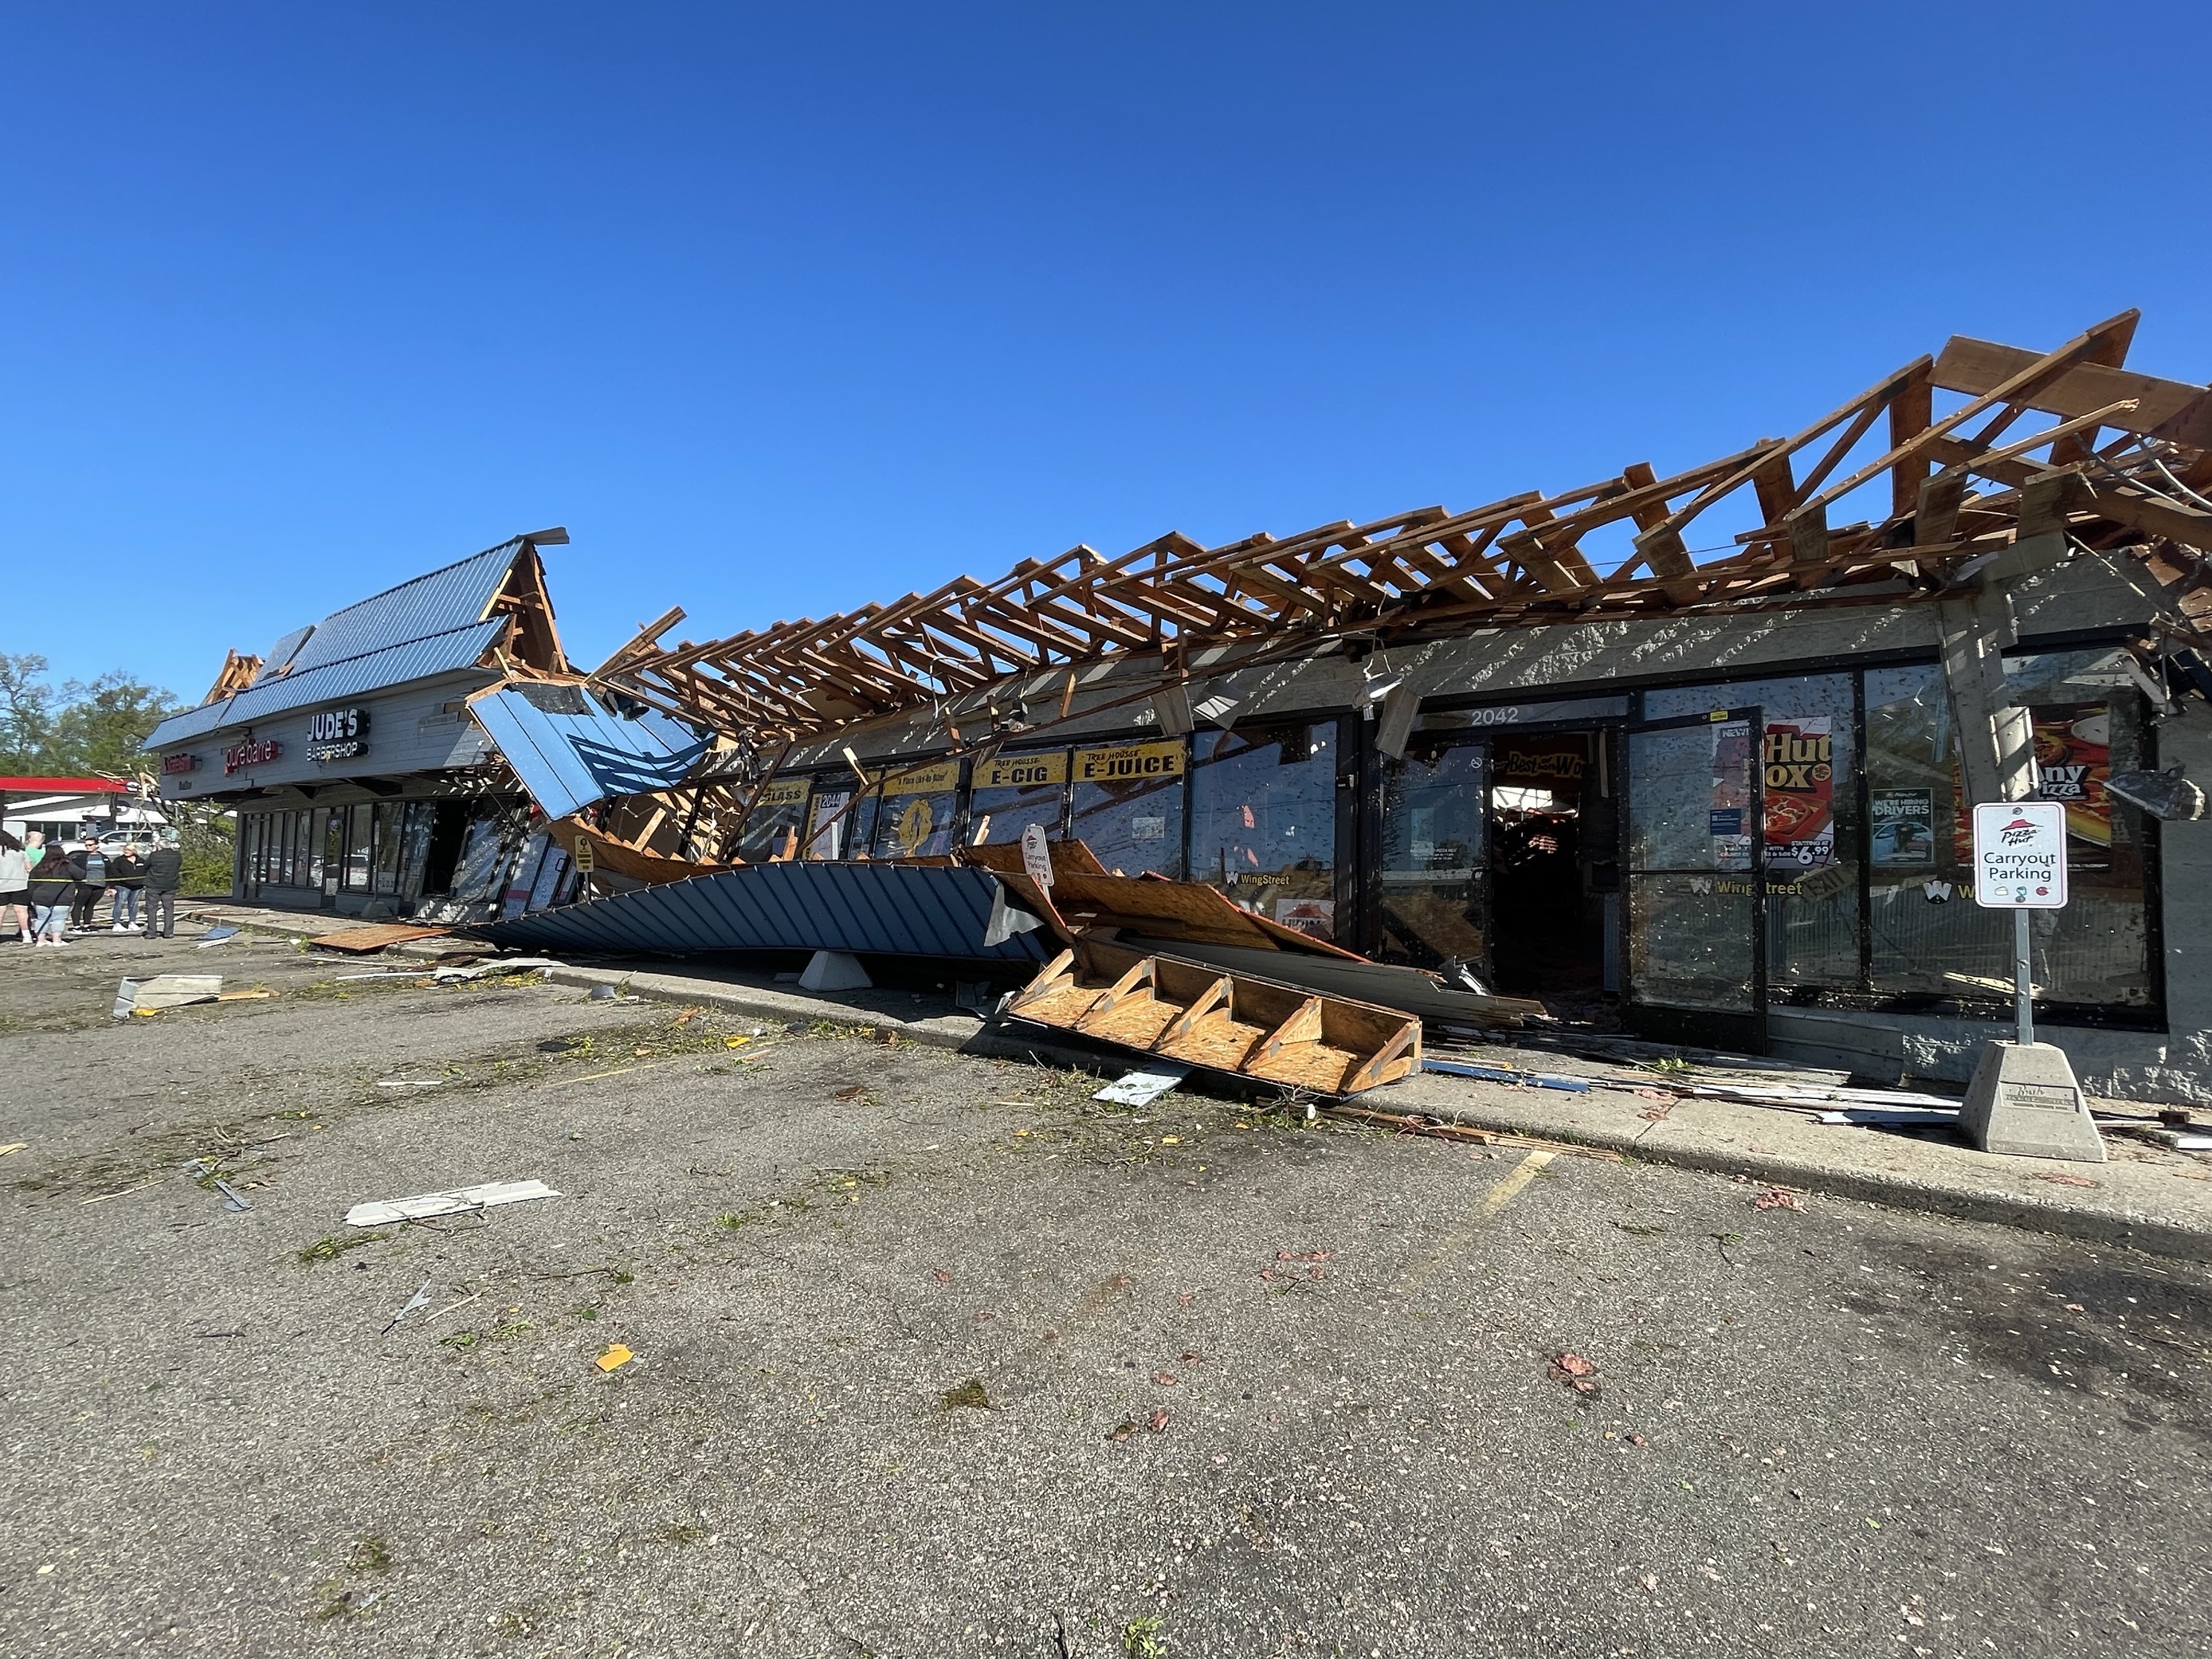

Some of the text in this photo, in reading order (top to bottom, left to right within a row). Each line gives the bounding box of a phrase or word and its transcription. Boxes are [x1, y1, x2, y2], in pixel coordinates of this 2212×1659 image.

[1472, 707, 1519, 726] 2042
[307, 708, 358, 742] JUDE'S
[306, 742, 358, 762] BARBERSHOP
[1766, 732, 1832, 763] Hut
[994, 759, 1011, 769] TREE
[1086, 752, 1107, 763] TREE
[1508, 752, 1538, 775] Best
[1084, 755, 1175, 778] E-JUICE
[991, 767, 1048, 785] E-CIG
[1766, 765, 1812, 788] ox
[763, 790, 802, 802] GLASS
[2038, 781, 2081, 796] izza
[822, 794, 841, 807] 2044
[1875, 806, 1930, 815] DRIVERS
[2001, 829, 2040, 843] Pizza
[2008, 836, 2034, 846] Hut
[1791, 846, 1830, 865] $6.99
[1984, 853, 2057, 866] Carryout
[1241, 874, 1289, 886] WingStreet
[1990, 868, 2052, 882] Parking
[1717, 881, 1803, 896] Wingtreet
[1804, 870, 1846, 896] EXIT
